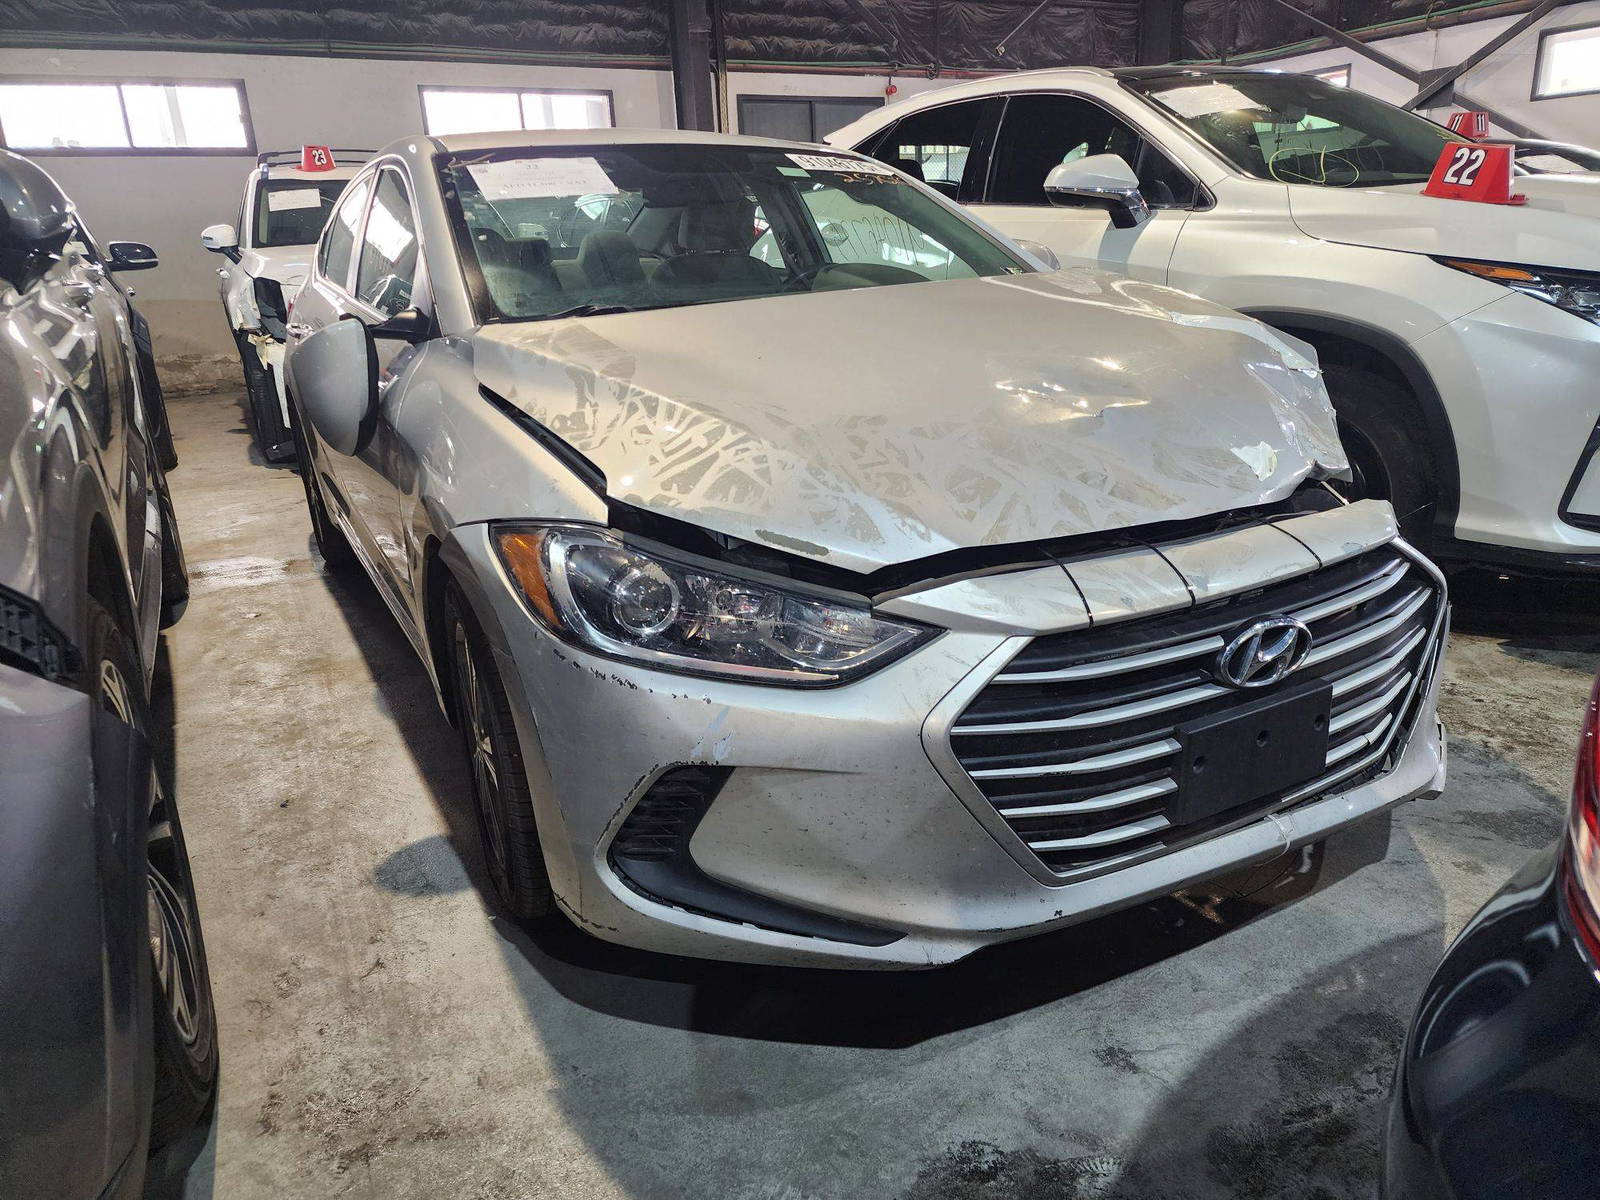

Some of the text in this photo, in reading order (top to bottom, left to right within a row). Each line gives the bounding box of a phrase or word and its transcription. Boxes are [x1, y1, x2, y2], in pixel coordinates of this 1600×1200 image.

[1477, 114, 1486, 132] 11
[311, 149, 327, 166] 23
[1443, 147, 1487, 186] 22
